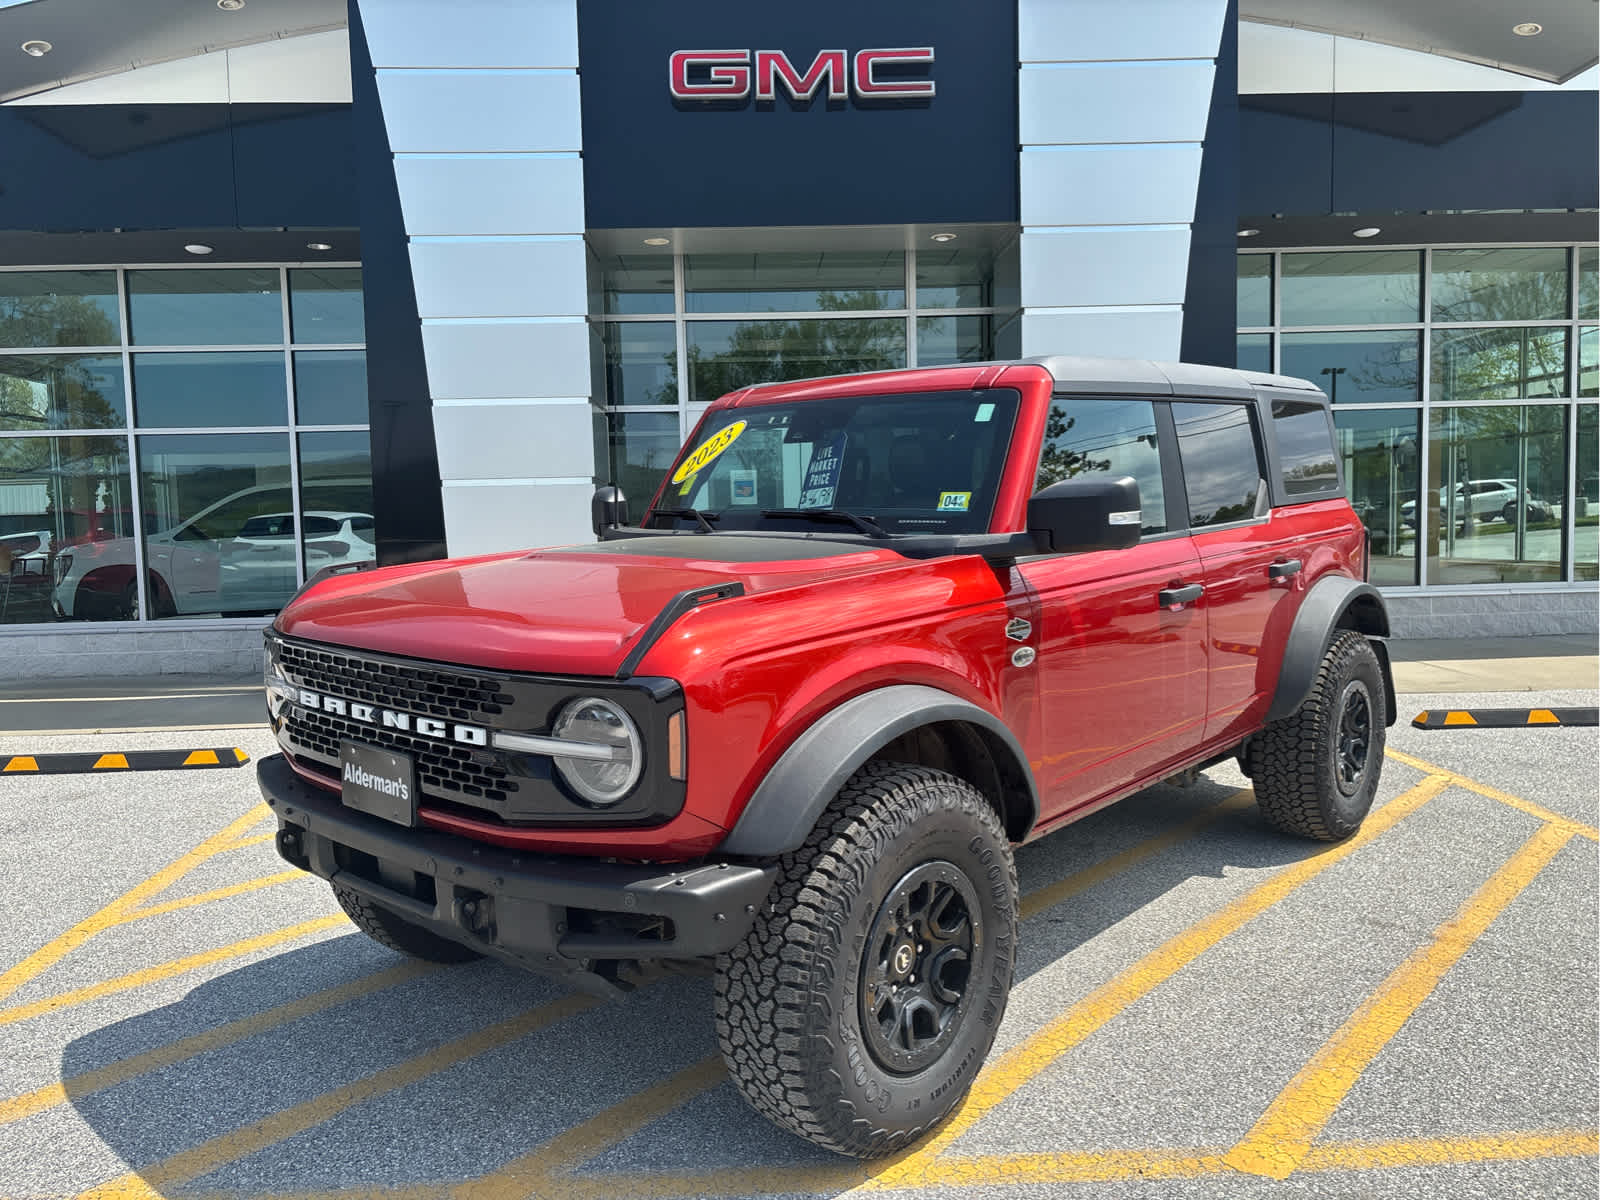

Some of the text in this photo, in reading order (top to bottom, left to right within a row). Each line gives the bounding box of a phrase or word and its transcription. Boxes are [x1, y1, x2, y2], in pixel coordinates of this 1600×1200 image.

[669, 47, 936, 100] GMC
[685, 427, 734, 477] 2023
[809, 457, 838, 474] MARKET
[816, 446, 833, 460] LIVE
[808, 472, 831, 487] PRICE
[300, 690, 487, 747] BRONCO
[343, 761, 409, 801] Alderman's
